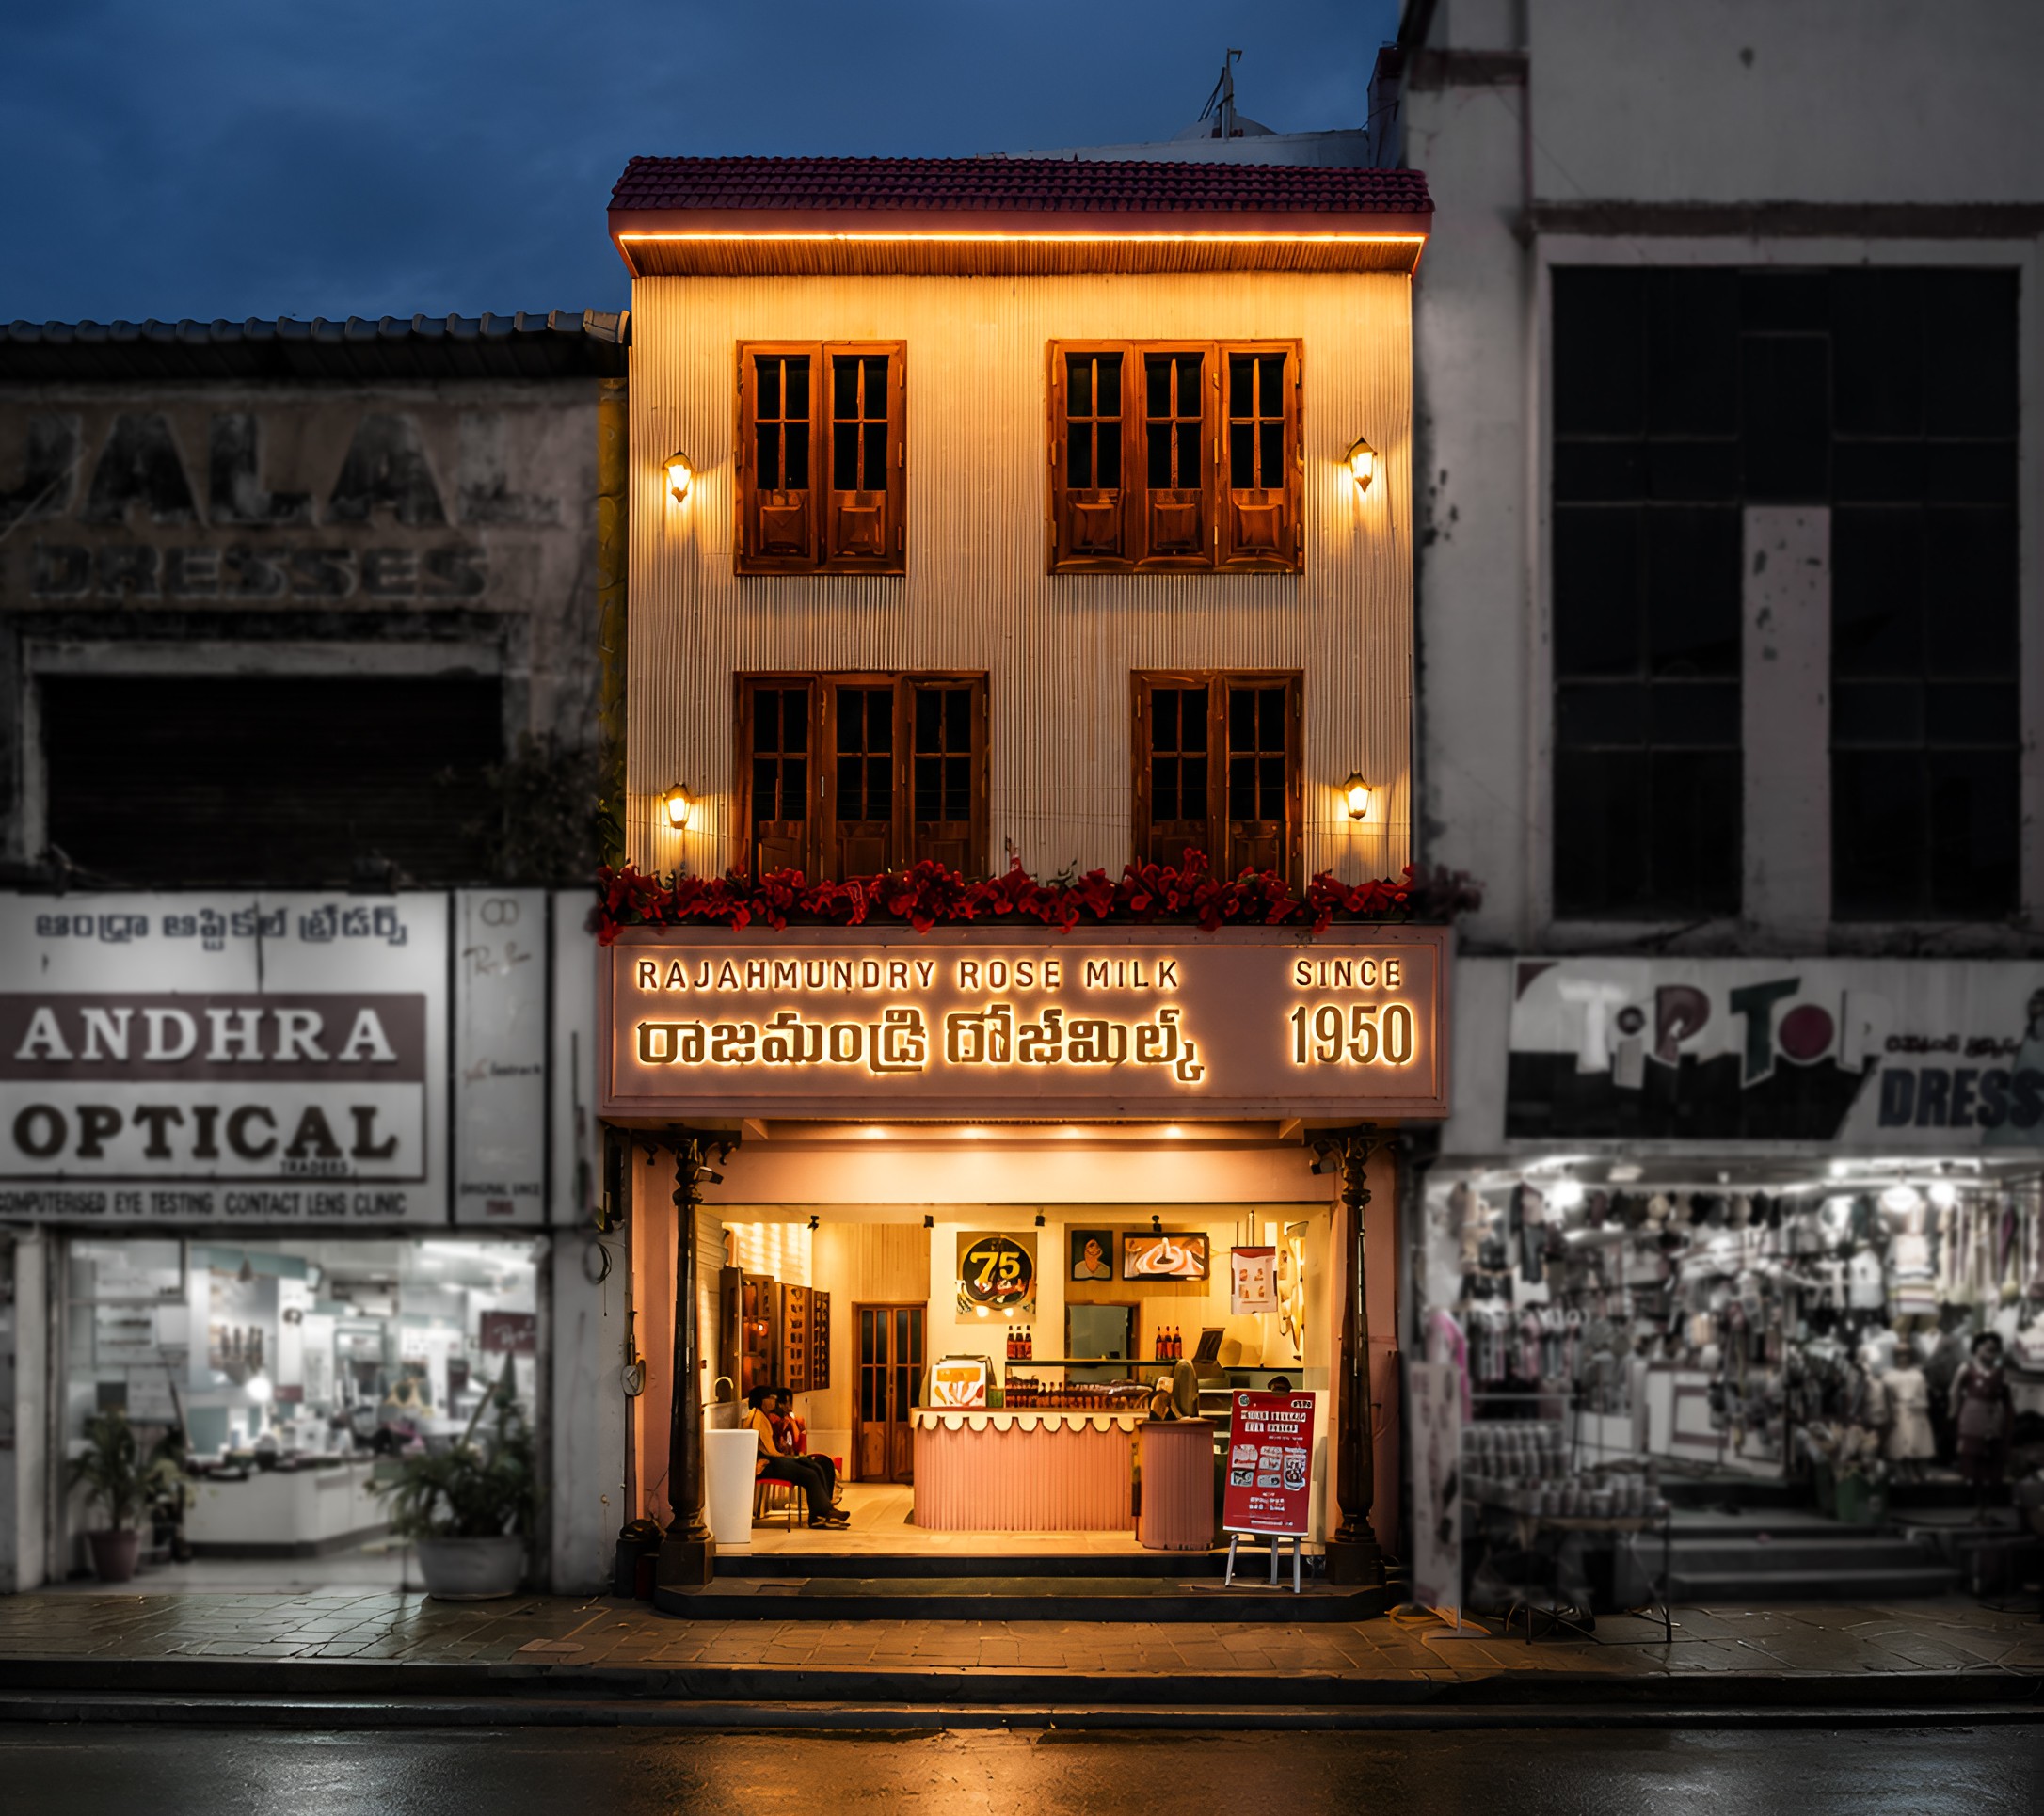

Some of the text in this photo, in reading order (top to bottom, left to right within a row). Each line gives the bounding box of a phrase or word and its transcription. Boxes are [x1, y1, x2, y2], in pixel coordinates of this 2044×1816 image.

[29, 540, 487, 600] DRESSES
[639, 960, 1178, 988] RAJAHMUNDRY ROSE MILK
[1296, 960, 1401, 987] SINCE
[14, 1008, 398, 1061] ANDHRA
[637, 1009, 927, 1072] రాజమండ్రి
[1291, 1004, 1412, 1064] 1950
[1877, 1068, 2044, 1129] DRESS
[12, 1103, 399, 1160] OPTICAL
[280, 1161, 349, 1175] TRADERS
[114, 1191, 142, 1214] EYE
[151, 1191, 214, 1214] TESTING
[225, 1191, 300, 1215] CONTACT
[307, 1192, 347, 1215] LENS
[353, 1192, 406, 1215] CLINIC
[970, 1251, 1020, 1285] 75
